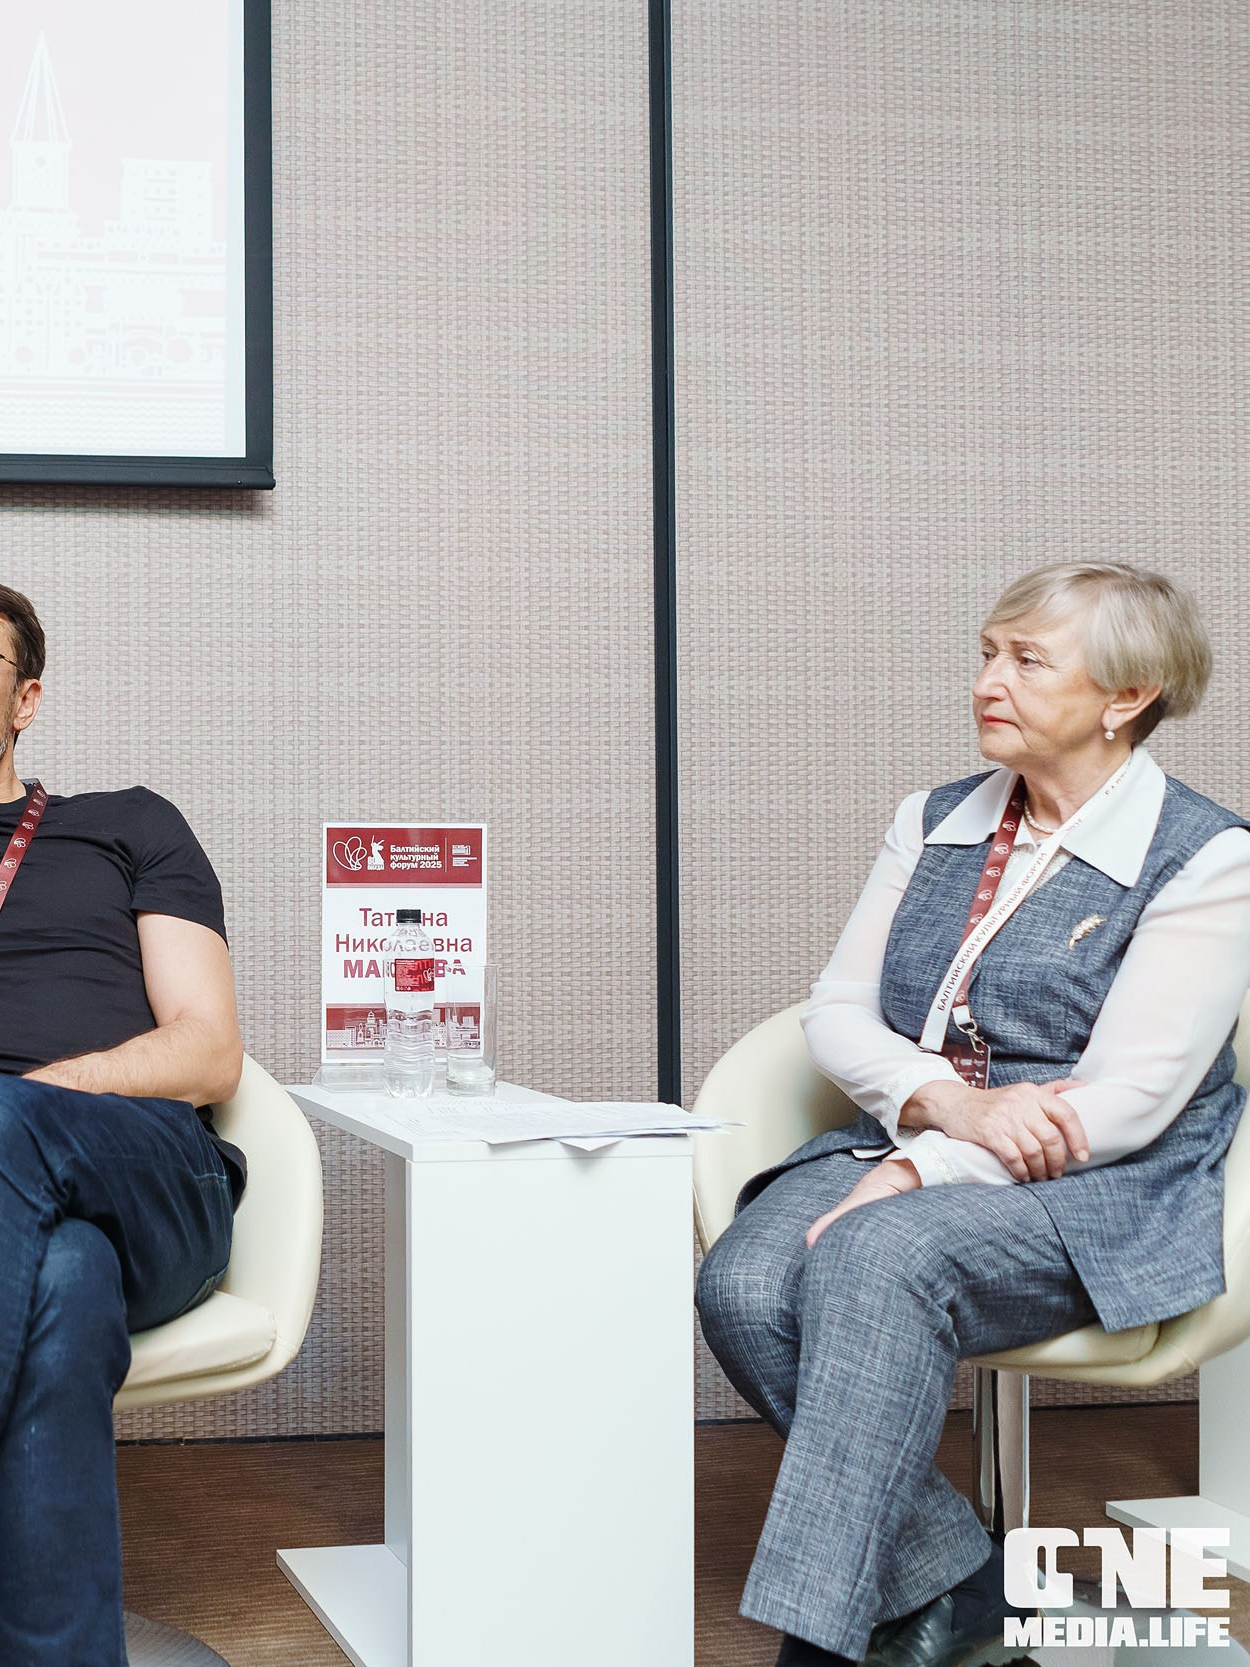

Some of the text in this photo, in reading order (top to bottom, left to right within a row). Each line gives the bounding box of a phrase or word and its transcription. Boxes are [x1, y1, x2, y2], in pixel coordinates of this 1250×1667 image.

[390, 844, 440, 853] Балтийский
[390, 853, 439, 862] культурный
[390, 861, 418, 870] форум
[420, 860, 442, 869] 2025
[358, 907, 448, 927] Татна
